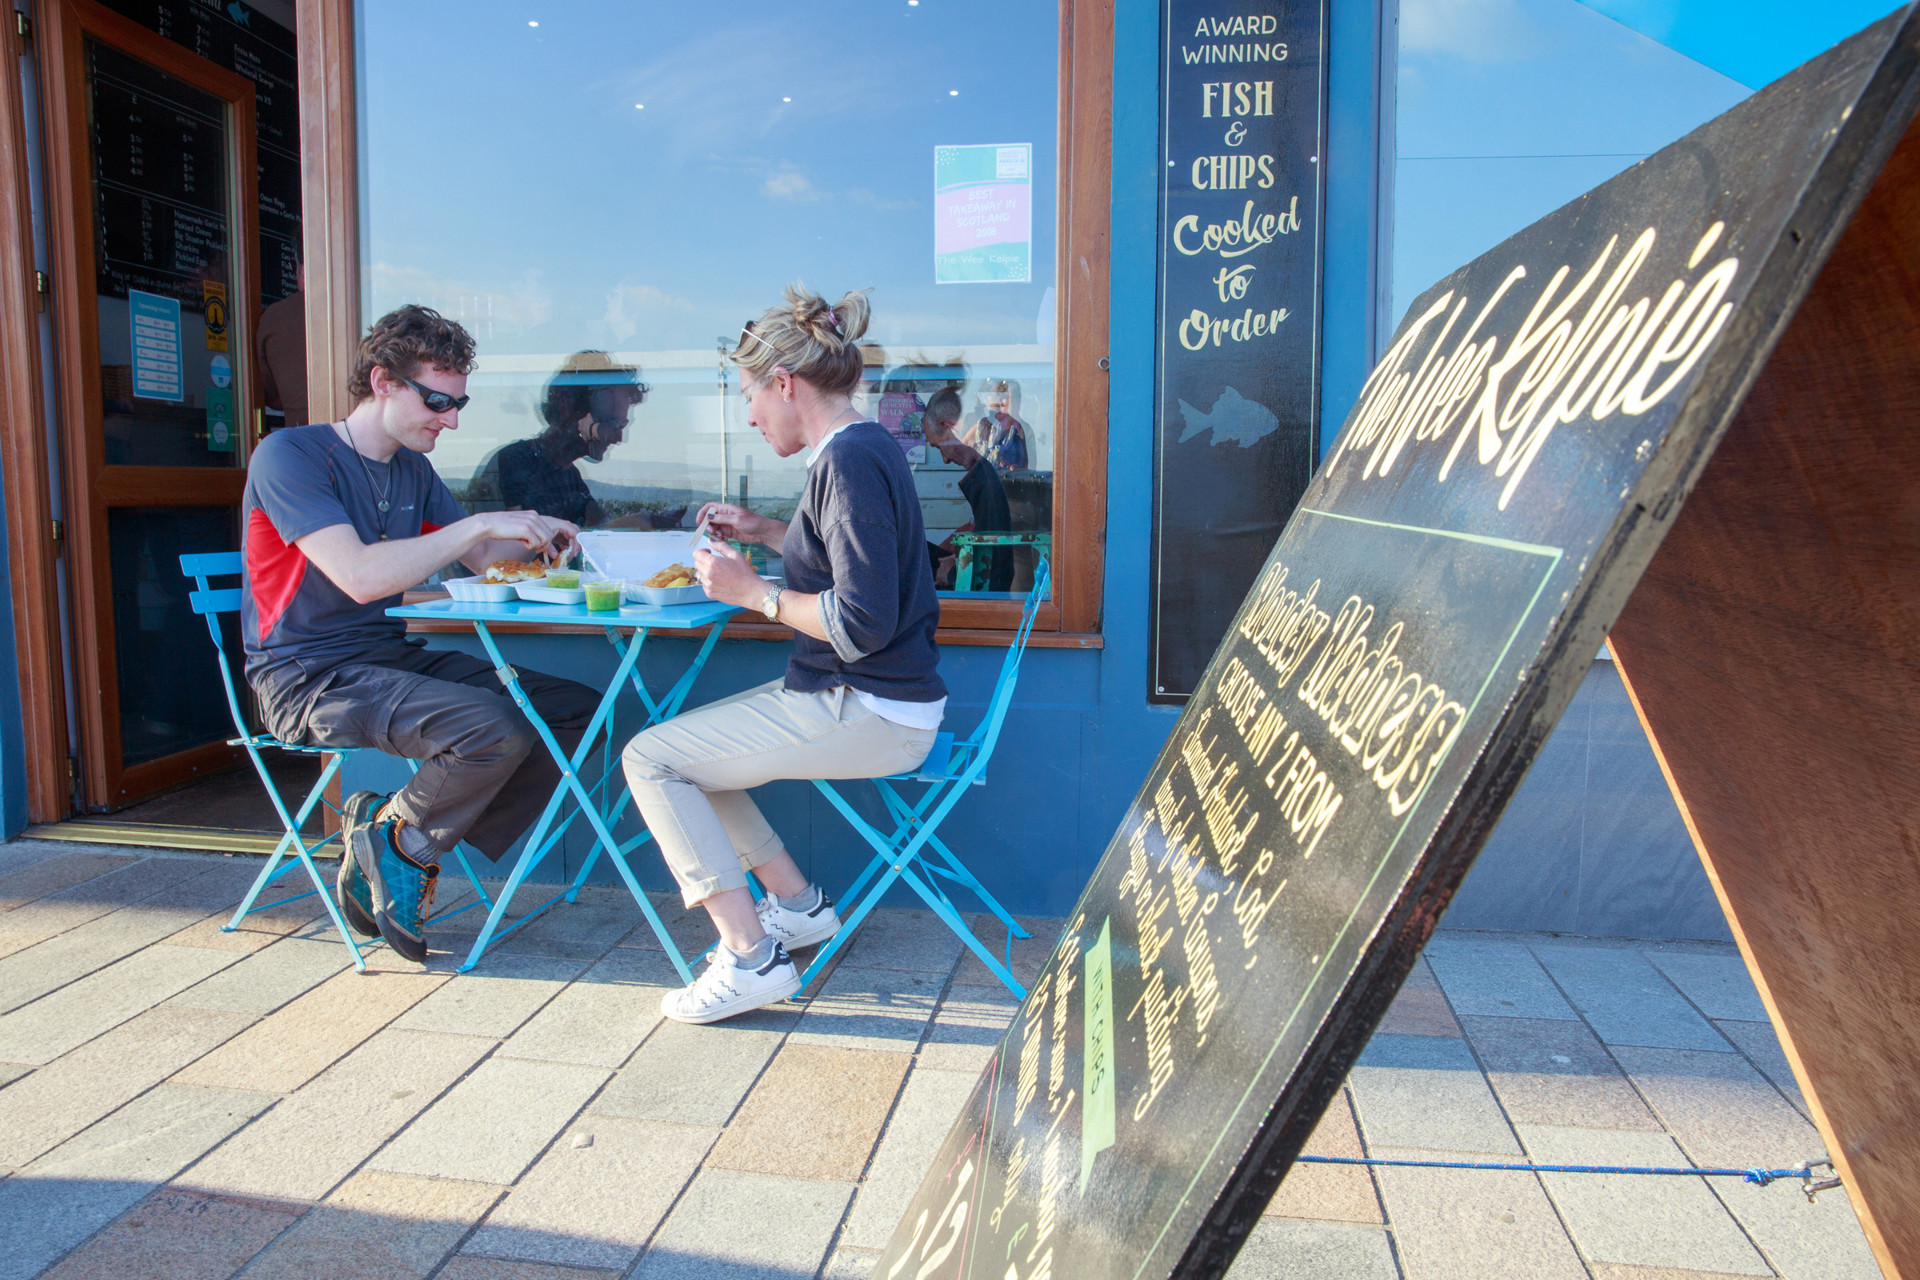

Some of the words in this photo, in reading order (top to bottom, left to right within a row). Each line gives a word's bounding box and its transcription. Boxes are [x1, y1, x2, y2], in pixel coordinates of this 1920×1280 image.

[1182, 43, 1288, 64] WINNING
[1195, 15, 1277, 37] AWARD
[1202, 81, 1274, 118] FISH
[1225, 121, 1247, 147] &
[968, 188, 994, 201] BEST
[1192, 154, 1275, 190] CHIPS
[947, 200, 1003, 217] TAKEAWAY
[1005, 199, 1017, 209] IN
[956, 212, 1011, 228] SCOTLAND
[975, 227, 998, 239] 2018
[1174, 196, 1301, 258] Cooked
[938, 255, 956, 265] The
[961, 255, 985, 264] Wee
[989, 253, 1020, 265] Kelpie
[1213, 264, 1256, 303] to
[1179, 307, 1294, 351] Order
[1325, 290, 1454, 478] The
[1362, 265, 1526, 481] Wee
[1438, 221, 1737, 510] Kelpie
[1217, 657, 1266, 736] CHOOSE
[1236, 562, 1330, 688] Monday
[1298, 595, 1467, 817] Madness
[1182, 705, 1227, 800] Standard
[1244, 702, 1288, 767] ANY
[1265, 731, 1300, 789] 2
[1155, 760, 1186, 835] breast
[1274, 746, 1343, 860] FROM
[1119, 808, 1155, 900] Haggis
[1158, 812, 1194, 873] of
[1135, 879, 1152, 918] or
[1171, 833, 1206, 926] chicken
[1137, 885, 1173, 980] black
[1091, 960, 1104, 1015] WITH
[1013, 1019, 1042, 1126] DRINKS
[1091, 1018, 1105, 1096] CHIPS
[1127, 968, 1182, 1123] pudding
[1045, 1089, 1075, 1141] 1
[990, 1137, 1031, 1234] only
[1026, 1131, 1067, 1264] mushy
